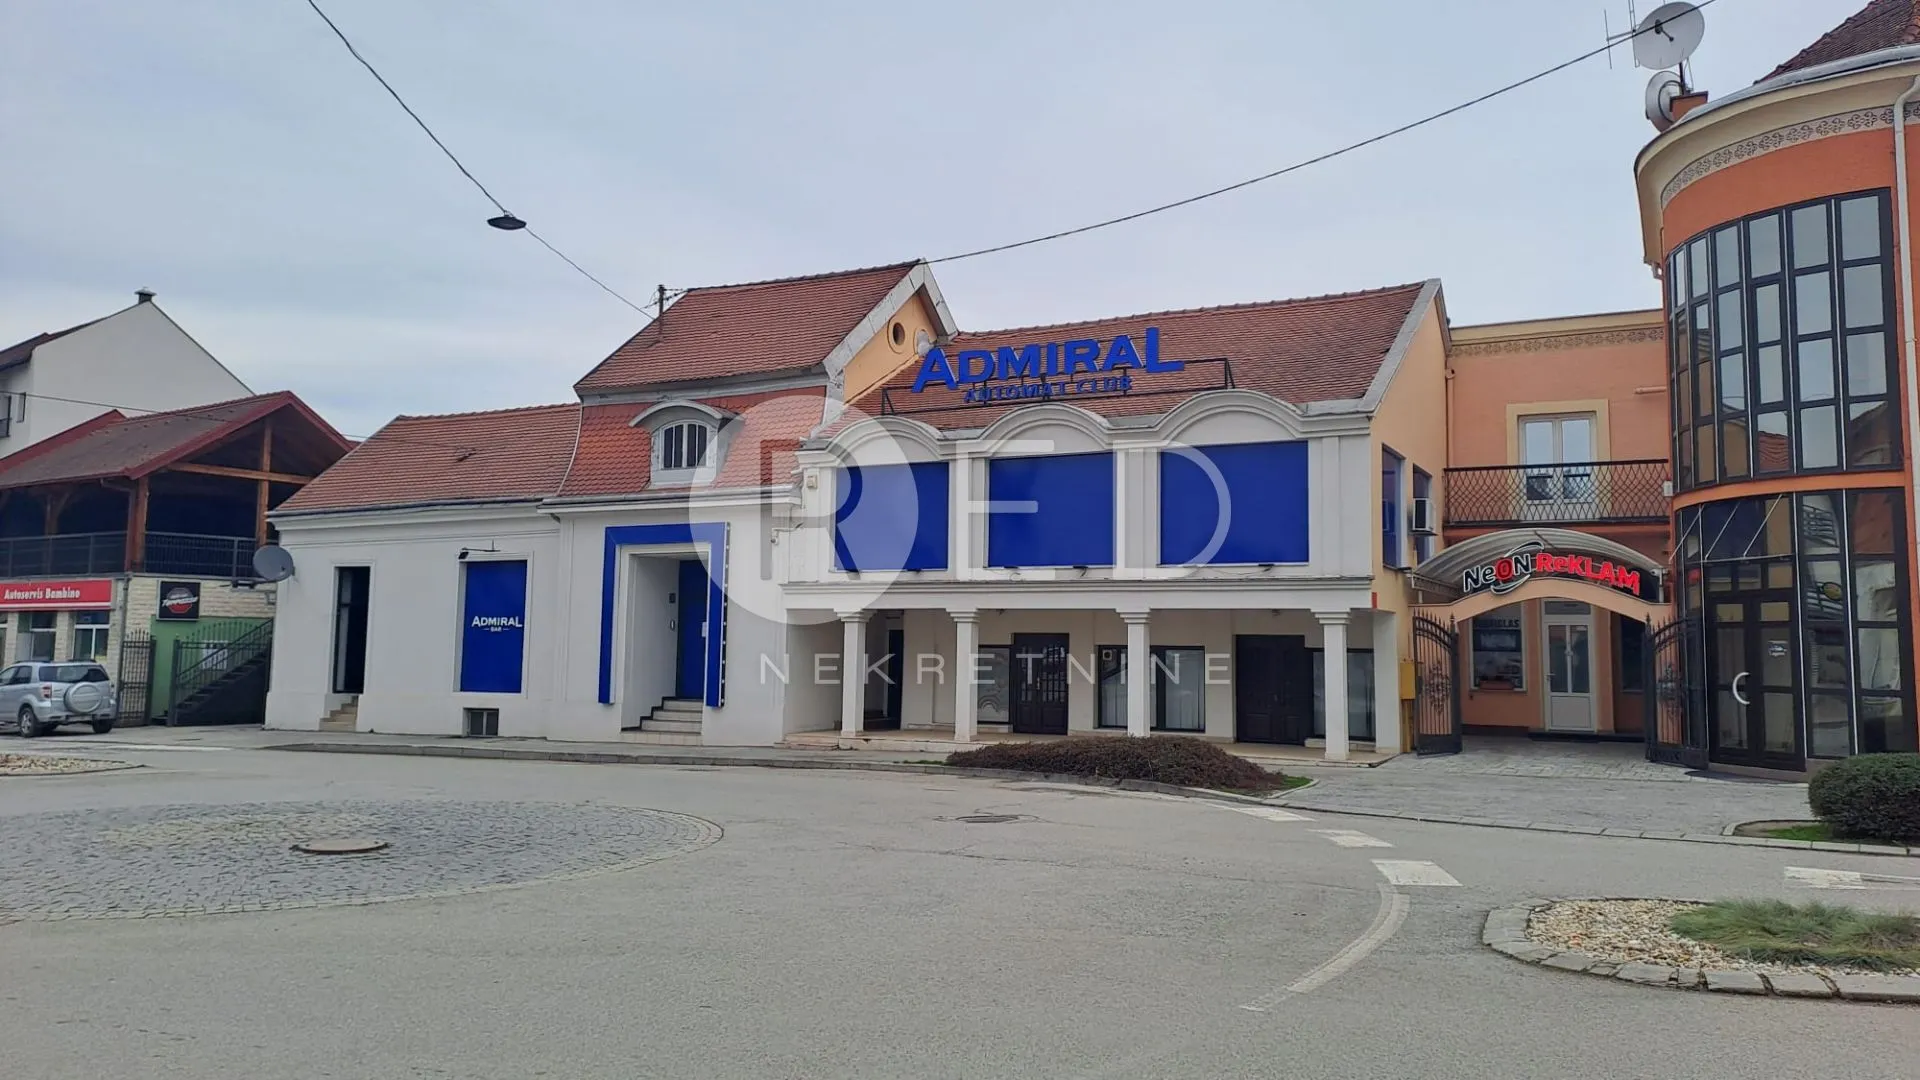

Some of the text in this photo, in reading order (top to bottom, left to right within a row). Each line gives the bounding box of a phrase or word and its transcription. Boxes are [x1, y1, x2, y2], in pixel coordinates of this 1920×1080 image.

[911, 326, 1185, 393] ADMIRAL
[964, 375, 1132, 404] AUTOMAT CLUB
[4, 587, 80, 600] Autoservis Bambino
[471, 615, 522, 627] ADMIRAL
